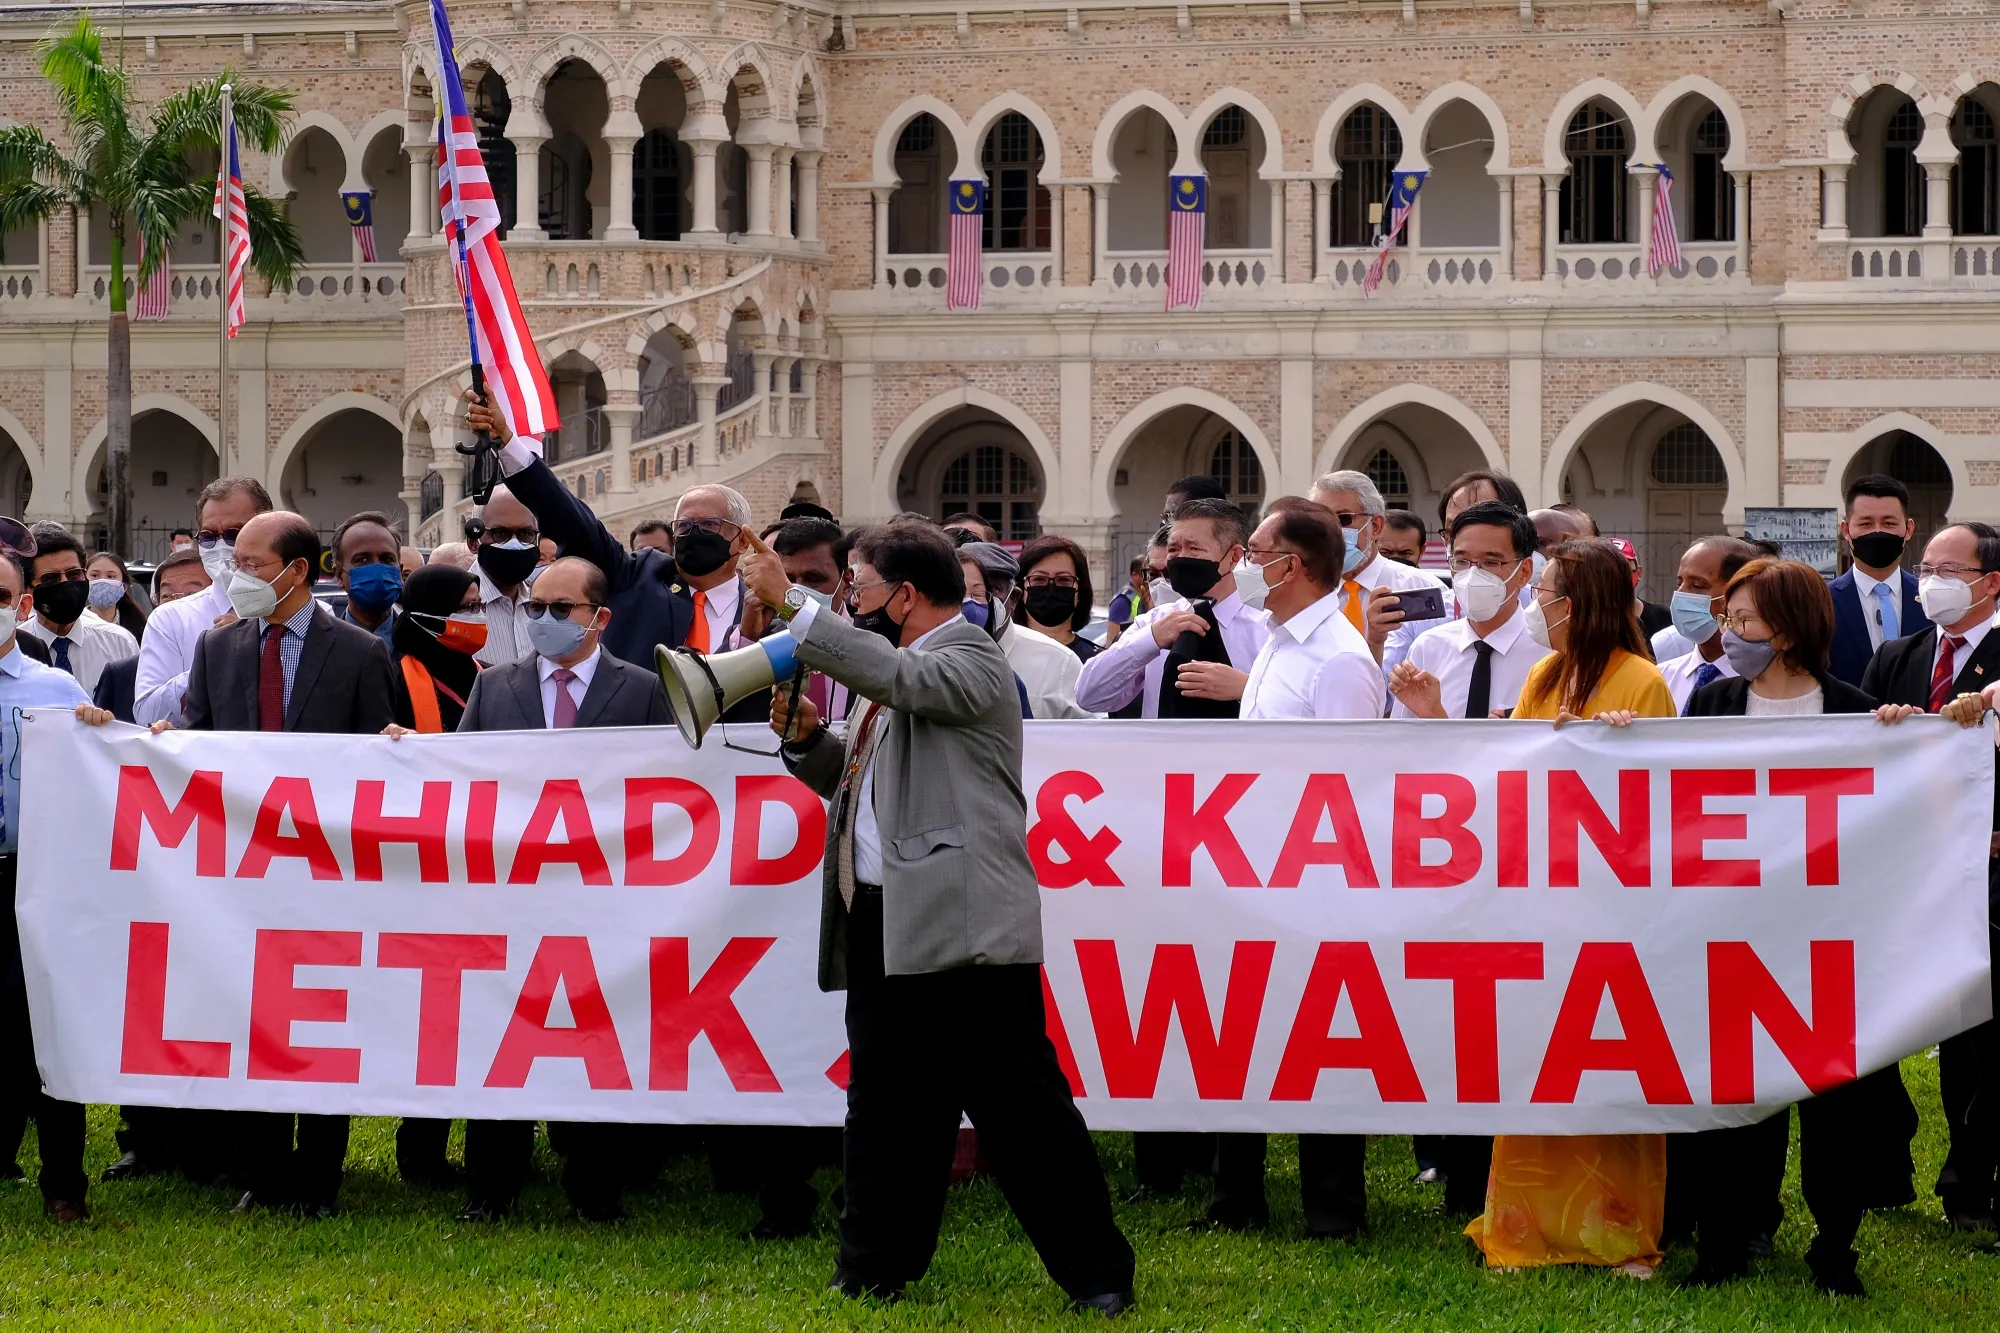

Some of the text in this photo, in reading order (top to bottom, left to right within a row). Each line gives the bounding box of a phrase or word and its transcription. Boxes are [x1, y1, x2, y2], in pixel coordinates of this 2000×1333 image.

[111, 765, 1874, 890] MAHIADD & KABINET
[121, 921, 1858, 1105] LETAK WATAN
